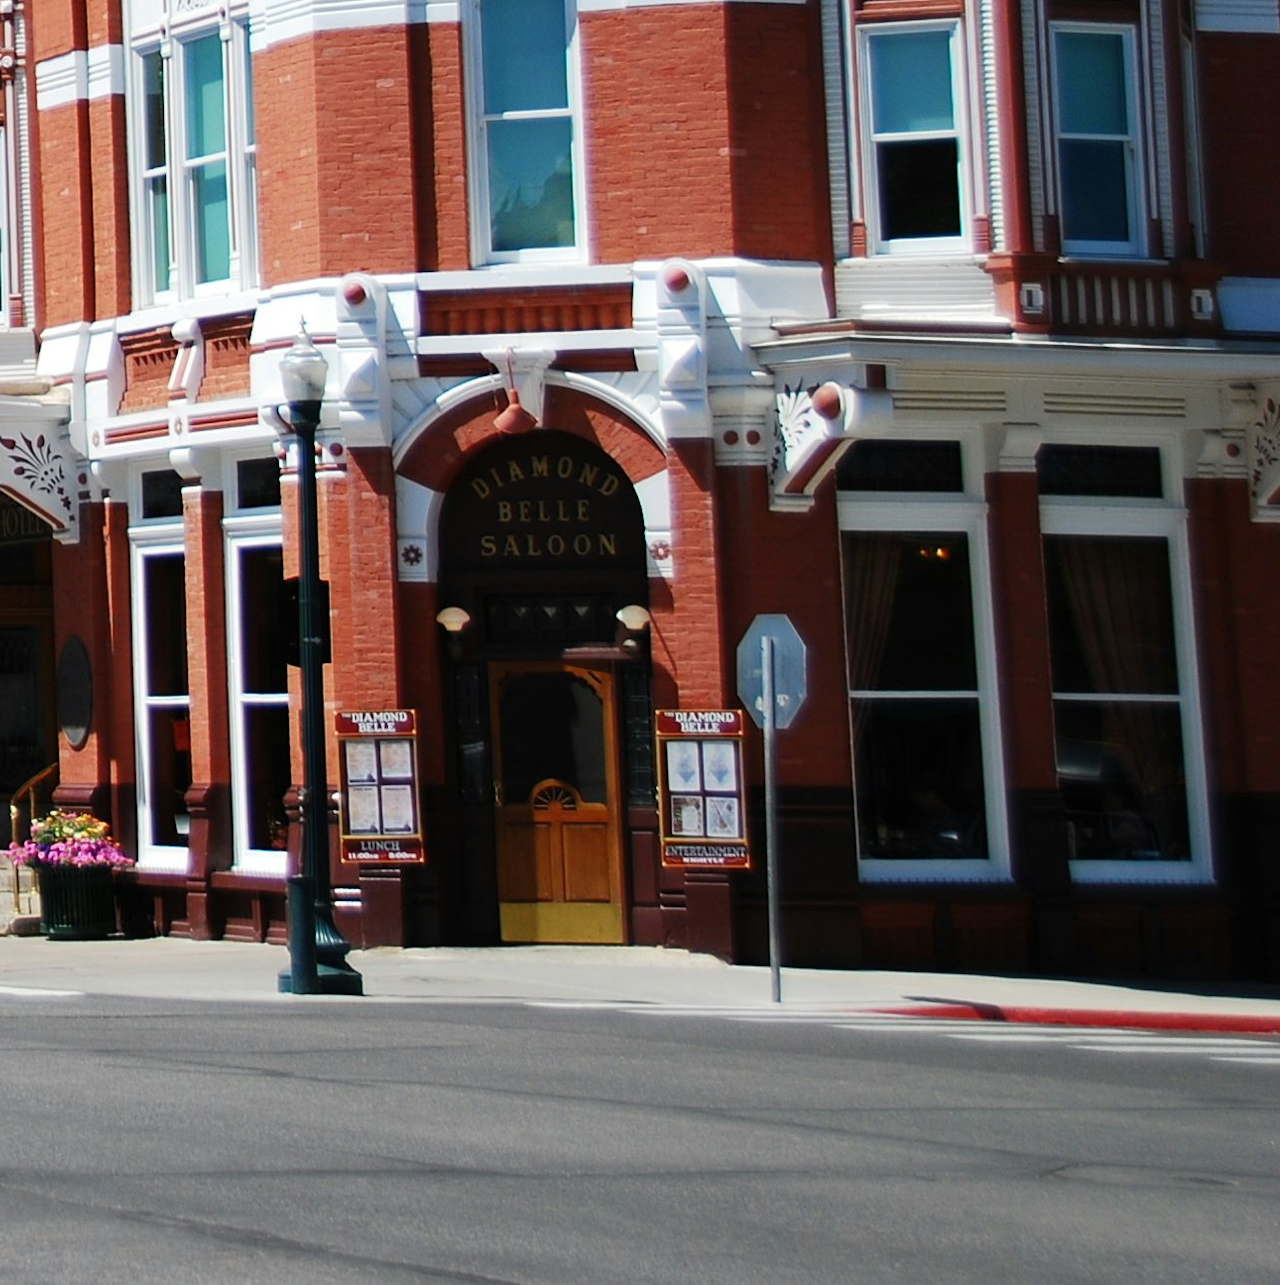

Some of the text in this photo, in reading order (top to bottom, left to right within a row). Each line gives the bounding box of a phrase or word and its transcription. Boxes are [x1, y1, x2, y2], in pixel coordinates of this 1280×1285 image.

[470, 455, 619, 499] DIAMOND
[497, 499, 590, 522] BELLE
[480, 534, 616, 557] SALOON
[351, 712, 408, 723] DIAMOND
[675, 712, 735, 722] DIAMOND
[358, 722, 396, 732] BELLE
[681, 722, 720, 732] BELLE
[361, 840, 400, 851] LUNCH
[665, 845, 746, 857] ENTERTAINMENT
